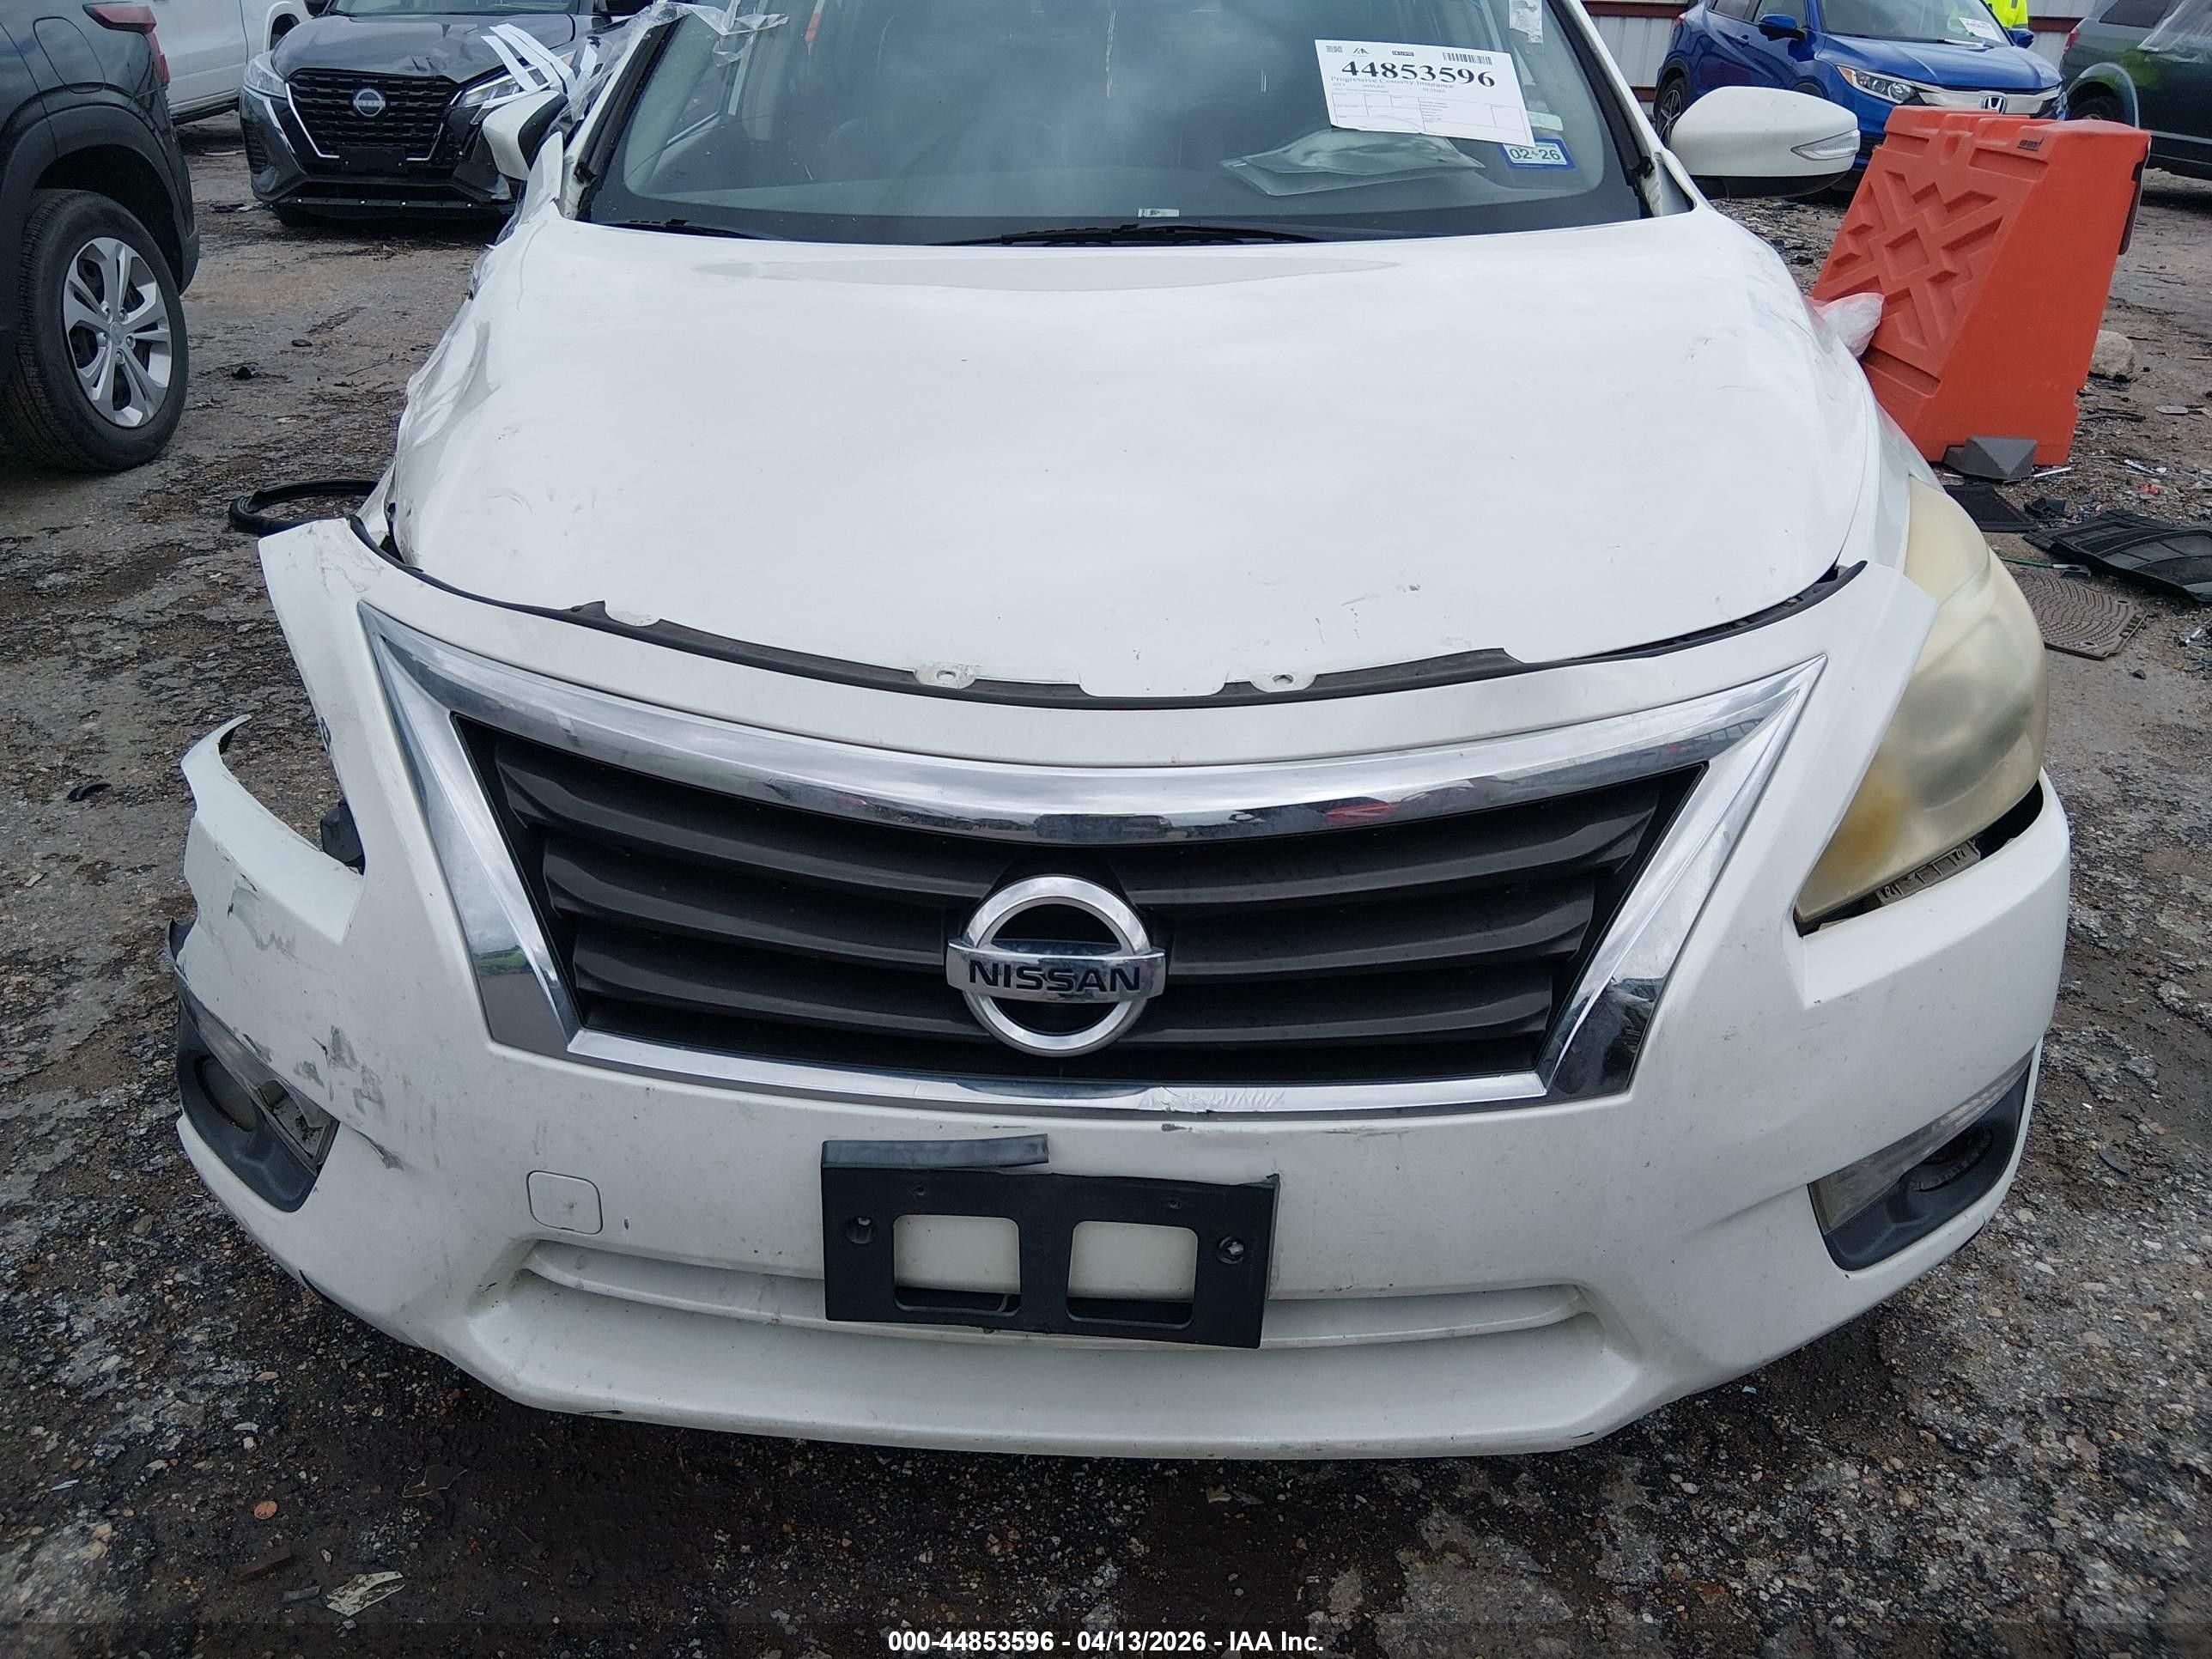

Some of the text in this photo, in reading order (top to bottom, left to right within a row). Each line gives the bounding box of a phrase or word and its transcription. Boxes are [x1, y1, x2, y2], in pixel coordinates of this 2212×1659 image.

[1341, 61, 1496, 88] 44853596
[1416, 80, 1455, 88] Insurance
[969, 960, 1140, 993] NISSAN
